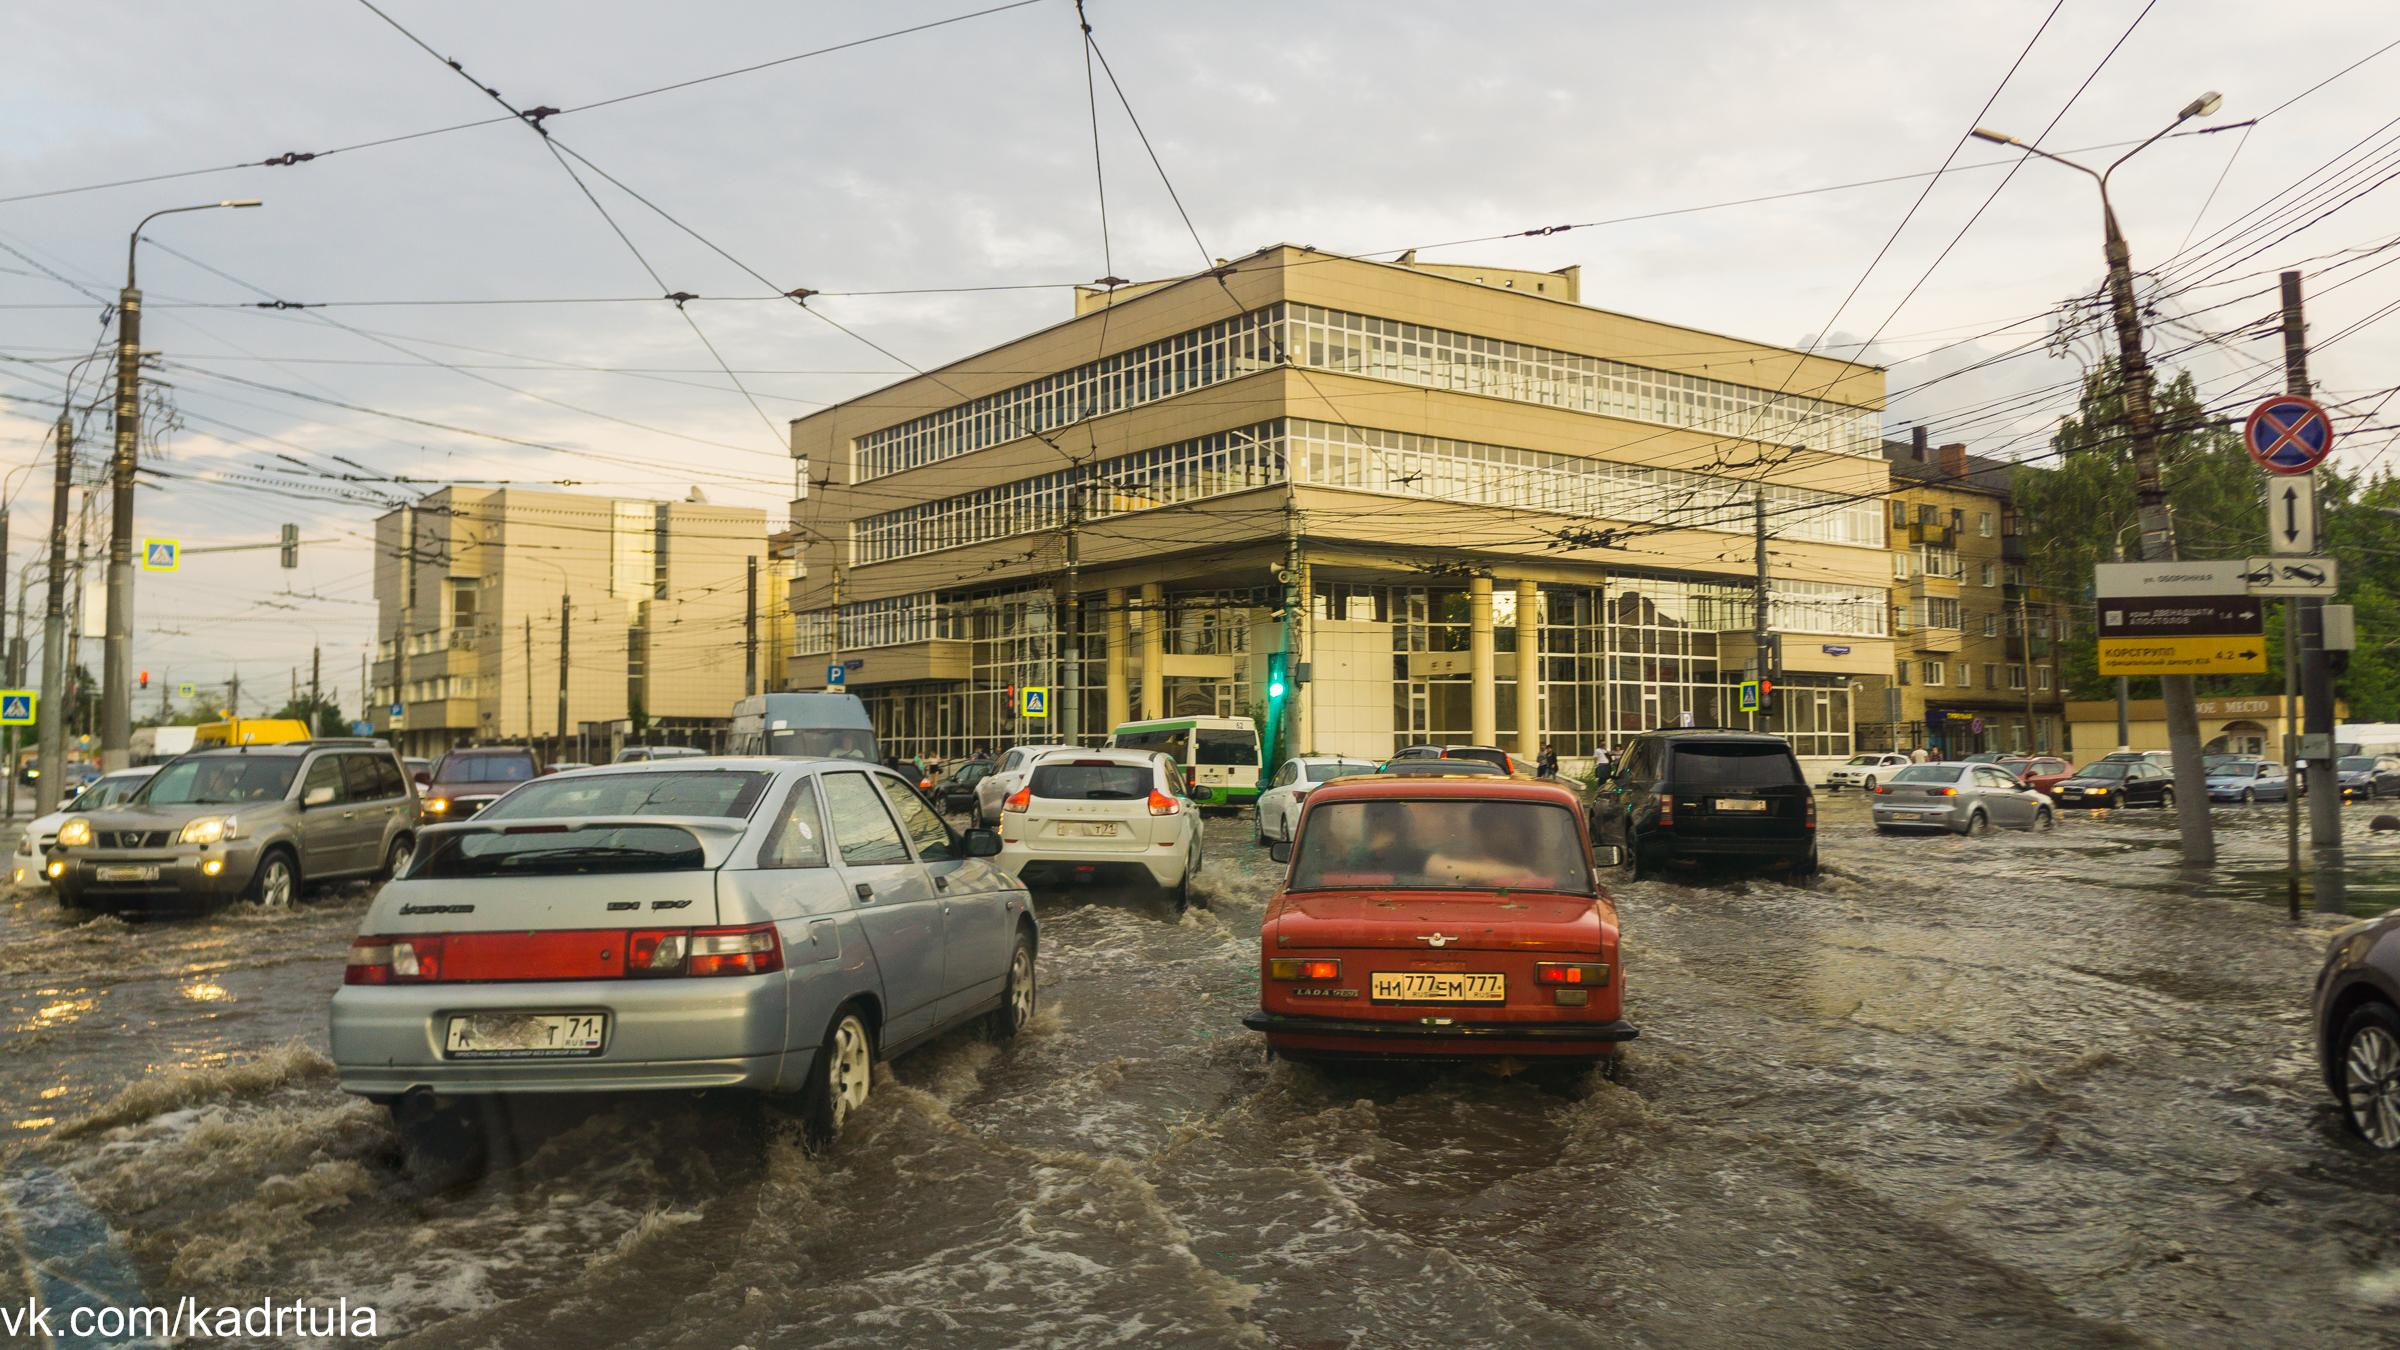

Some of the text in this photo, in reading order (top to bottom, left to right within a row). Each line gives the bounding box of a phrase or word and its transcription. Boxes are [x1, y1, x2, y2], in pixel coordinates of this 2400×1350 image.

[2157, 574, 2214, 583] ОБОРОННАЯ
[2152, 608, 2215, 618] ДВЕНАДЦАТИ
[2128, 616, 2192, 626] АПОСТОЛОВ
[2105, 647, 2235, 660] КОРСГРУПП 4.2
[2224, 700, 2269, 713] МЕСТО
[568, 1017, 593, 1038] 71
